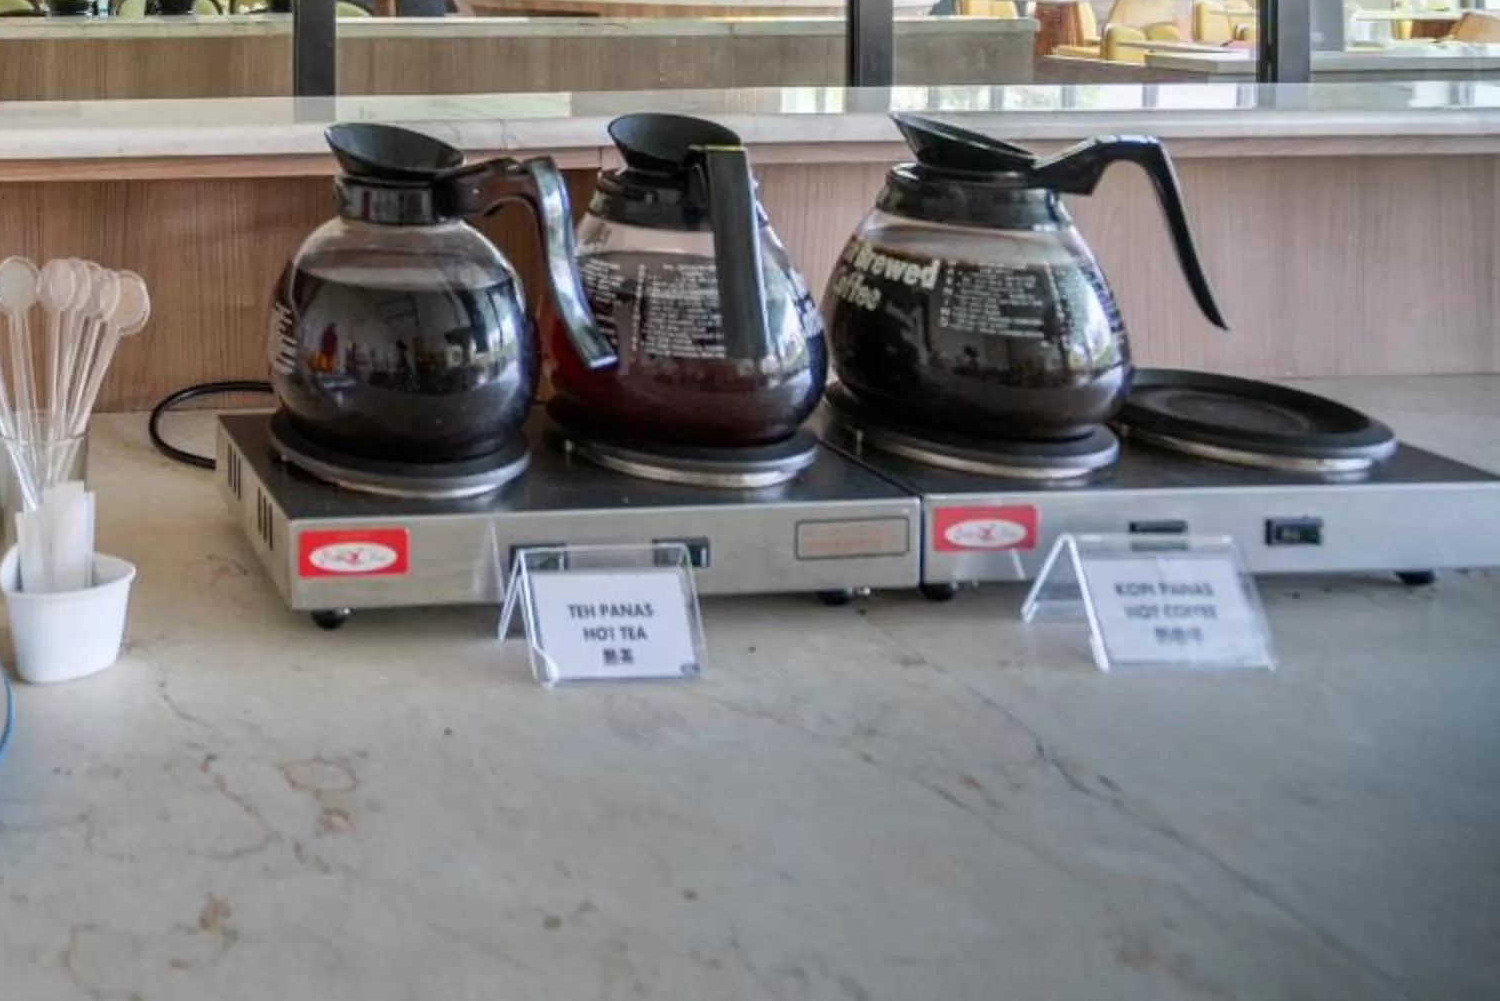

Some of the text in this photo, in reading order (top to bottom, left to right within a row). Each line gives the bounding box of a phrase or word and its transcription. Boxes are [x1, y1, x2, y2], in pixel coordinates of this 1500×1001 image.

[567, 601, 655, 620] TEH PANAS
[582, 625, 649, 641] HOT TEA
